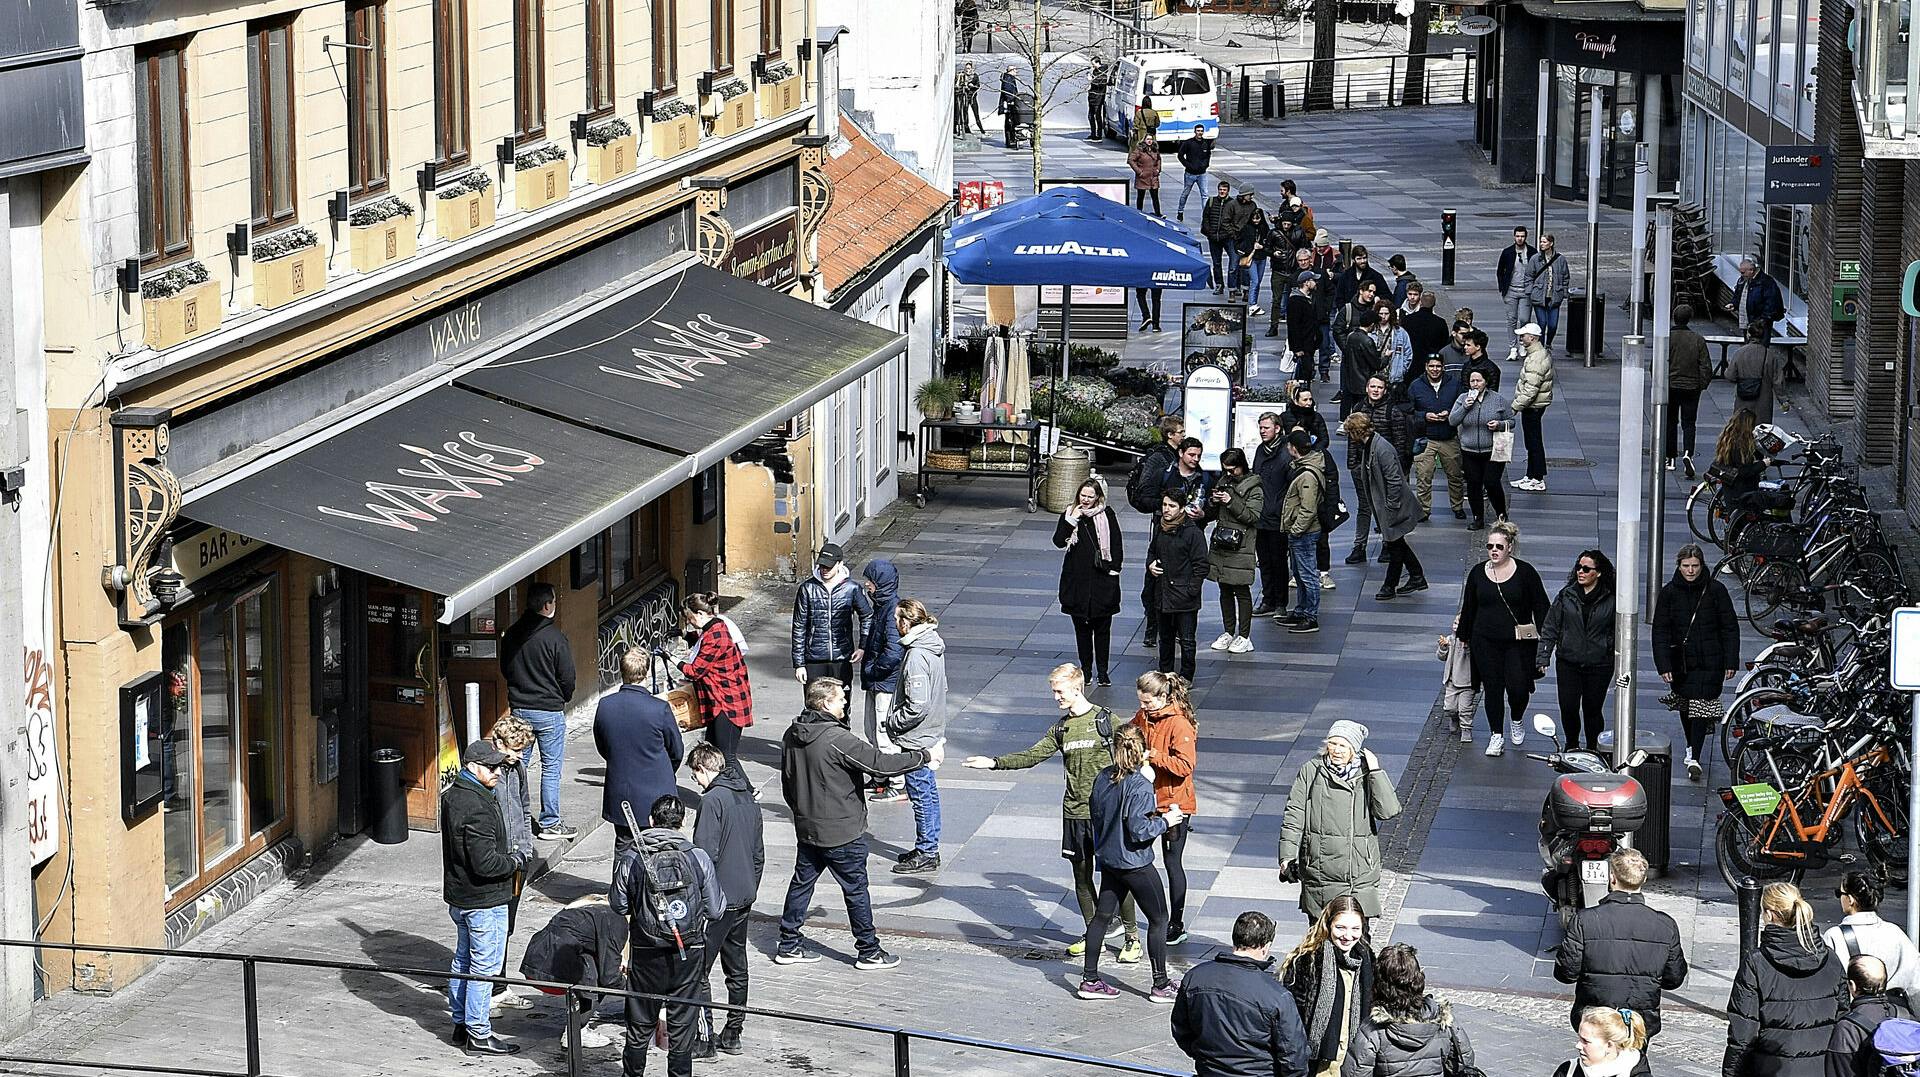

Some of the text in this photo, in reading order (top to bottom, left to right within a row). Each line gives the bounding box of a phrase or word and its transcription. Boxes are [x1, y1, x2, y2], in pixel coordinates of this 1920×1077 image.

[1462, 20, 1492, 31] Triumph
[1575, 32, 1616, 59] Triumph
[1772, 155, 1808, 164] Jutlander
[668, 225, 675, 245] 16
[1013, 241, 1130, 257] LAVAZZA
[1151, 269, 1192, 282] LAVAZZA
[598, 313, 771, 389] WAXIES
[317, 431, 545, 532] WAXIES
[200, 532, 228, 568] BAR
[1588, 862, 1601, 870] BZ
[1586, 870, 1605, 879] 314
